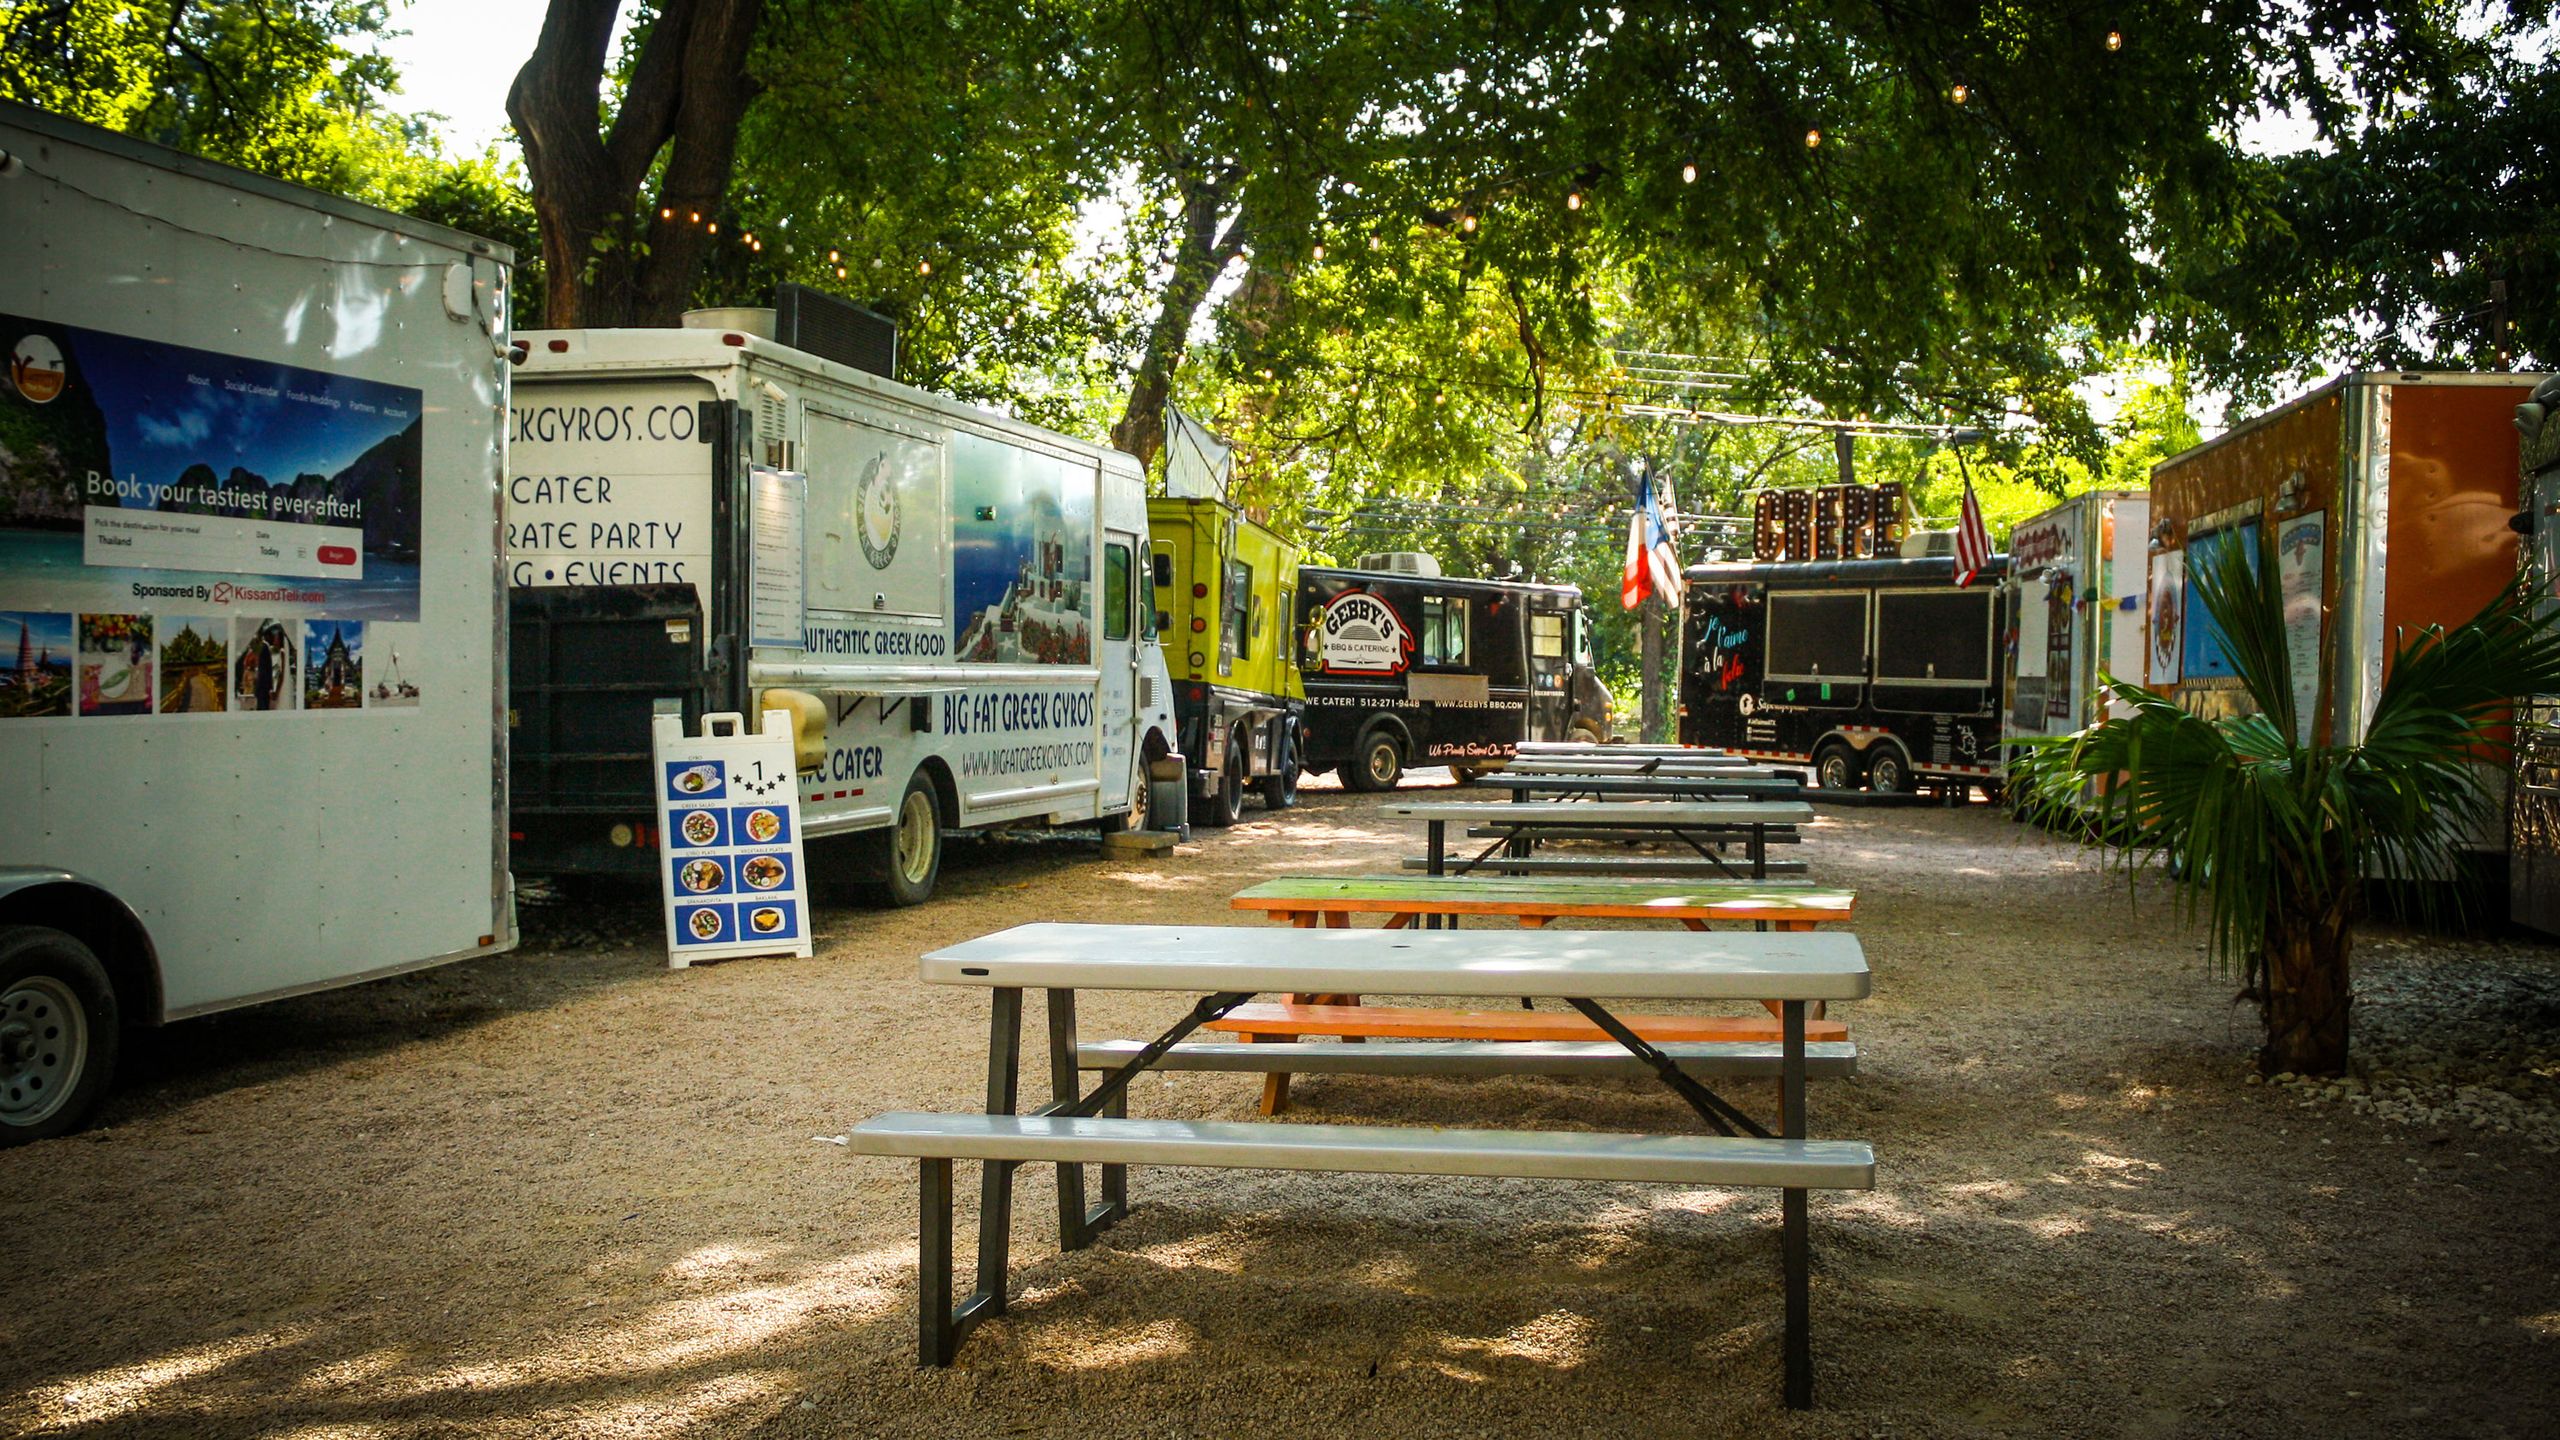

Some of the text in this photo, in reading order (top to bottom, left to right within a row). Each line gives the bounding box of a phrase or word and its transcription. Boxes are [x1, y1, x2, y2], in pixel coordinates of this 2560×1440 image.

[187, 374, 210, 386] About
[225, 379, 279, 397] Social Calendar
[349, 400, 376, 414] Partners
[383, 406, 408, 418] Account
[86, 470, 362, 519] Book your tastiest ever-after!
[511, 476, 611, 504] CATER
[110, 520, 121, 528] the
[1753, 482, 1906, 560] CREPE
[98, 534, 132, 546] Thailand
[591, 522, 682, 549] PARTY
[260, 546, 280, 558] Today
[565, 561, 685, 586] EVENTS
[132, 583, 193, 598] Sponsored
[197, 586, 211, 602] By
[1326, 599, 1394, 639] GEBBY'S
[804, 628, 946, 656] AUTHENTIC GREEK FOOD
[1331, 643, 1346, 651] BBQ
[1354, 644, 1390, 653] CATERING
[944, 693, 969, 735] BIG
[973, 693, 999, 733] FAT
[1002, 692, 1048, 732] GREEK
[1053, 691, 1094, 729] GYROS
[1305, 697, 1420, 708] WE CATER! 512-271-9448
[832, 746, 883, 782] CATER
[962, 741, 1094, 778] WWW.BIGFATGREEKGYROS.COM
[752, 760, 763, 781] 1
